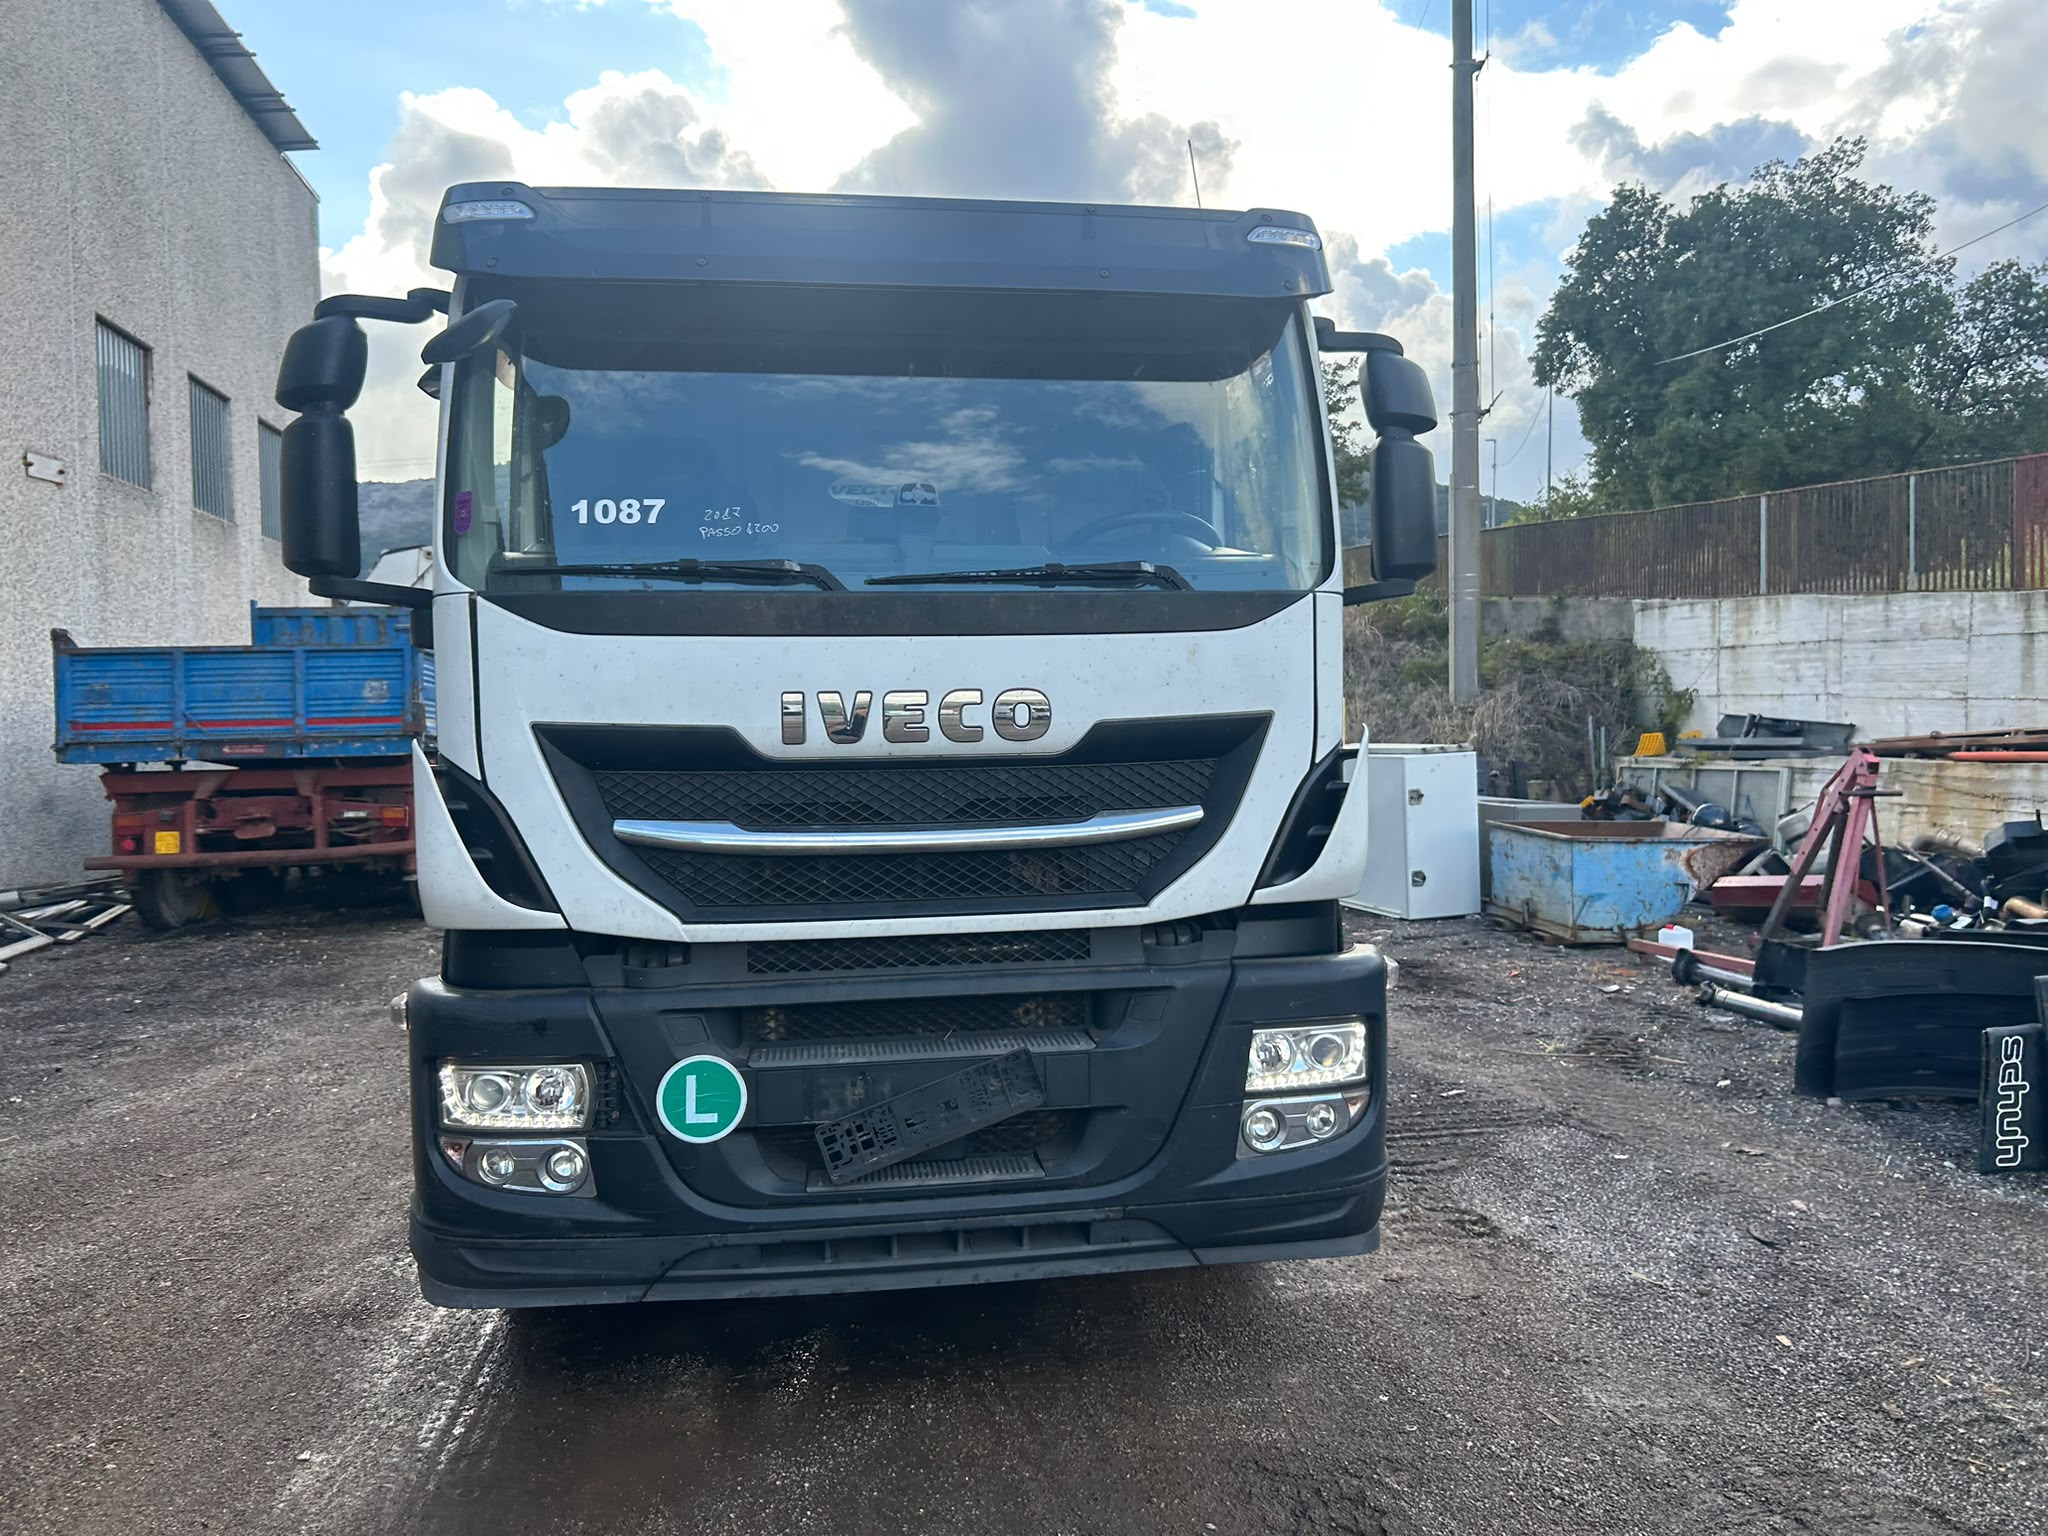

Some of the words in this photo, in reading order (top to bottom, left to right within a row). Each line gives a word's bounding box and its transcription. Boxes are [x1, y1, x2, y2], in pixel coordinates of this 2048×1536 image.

[571, 499, 666, 524] 1087
[703, 506, 742, 521] 2017
[698, 525, 742, 540] PASSO
[781, 687, 1052, 746] IVECO
[685, 1074, 718, 1124] L
[1996, 1035, 2030, 1167] schuh
